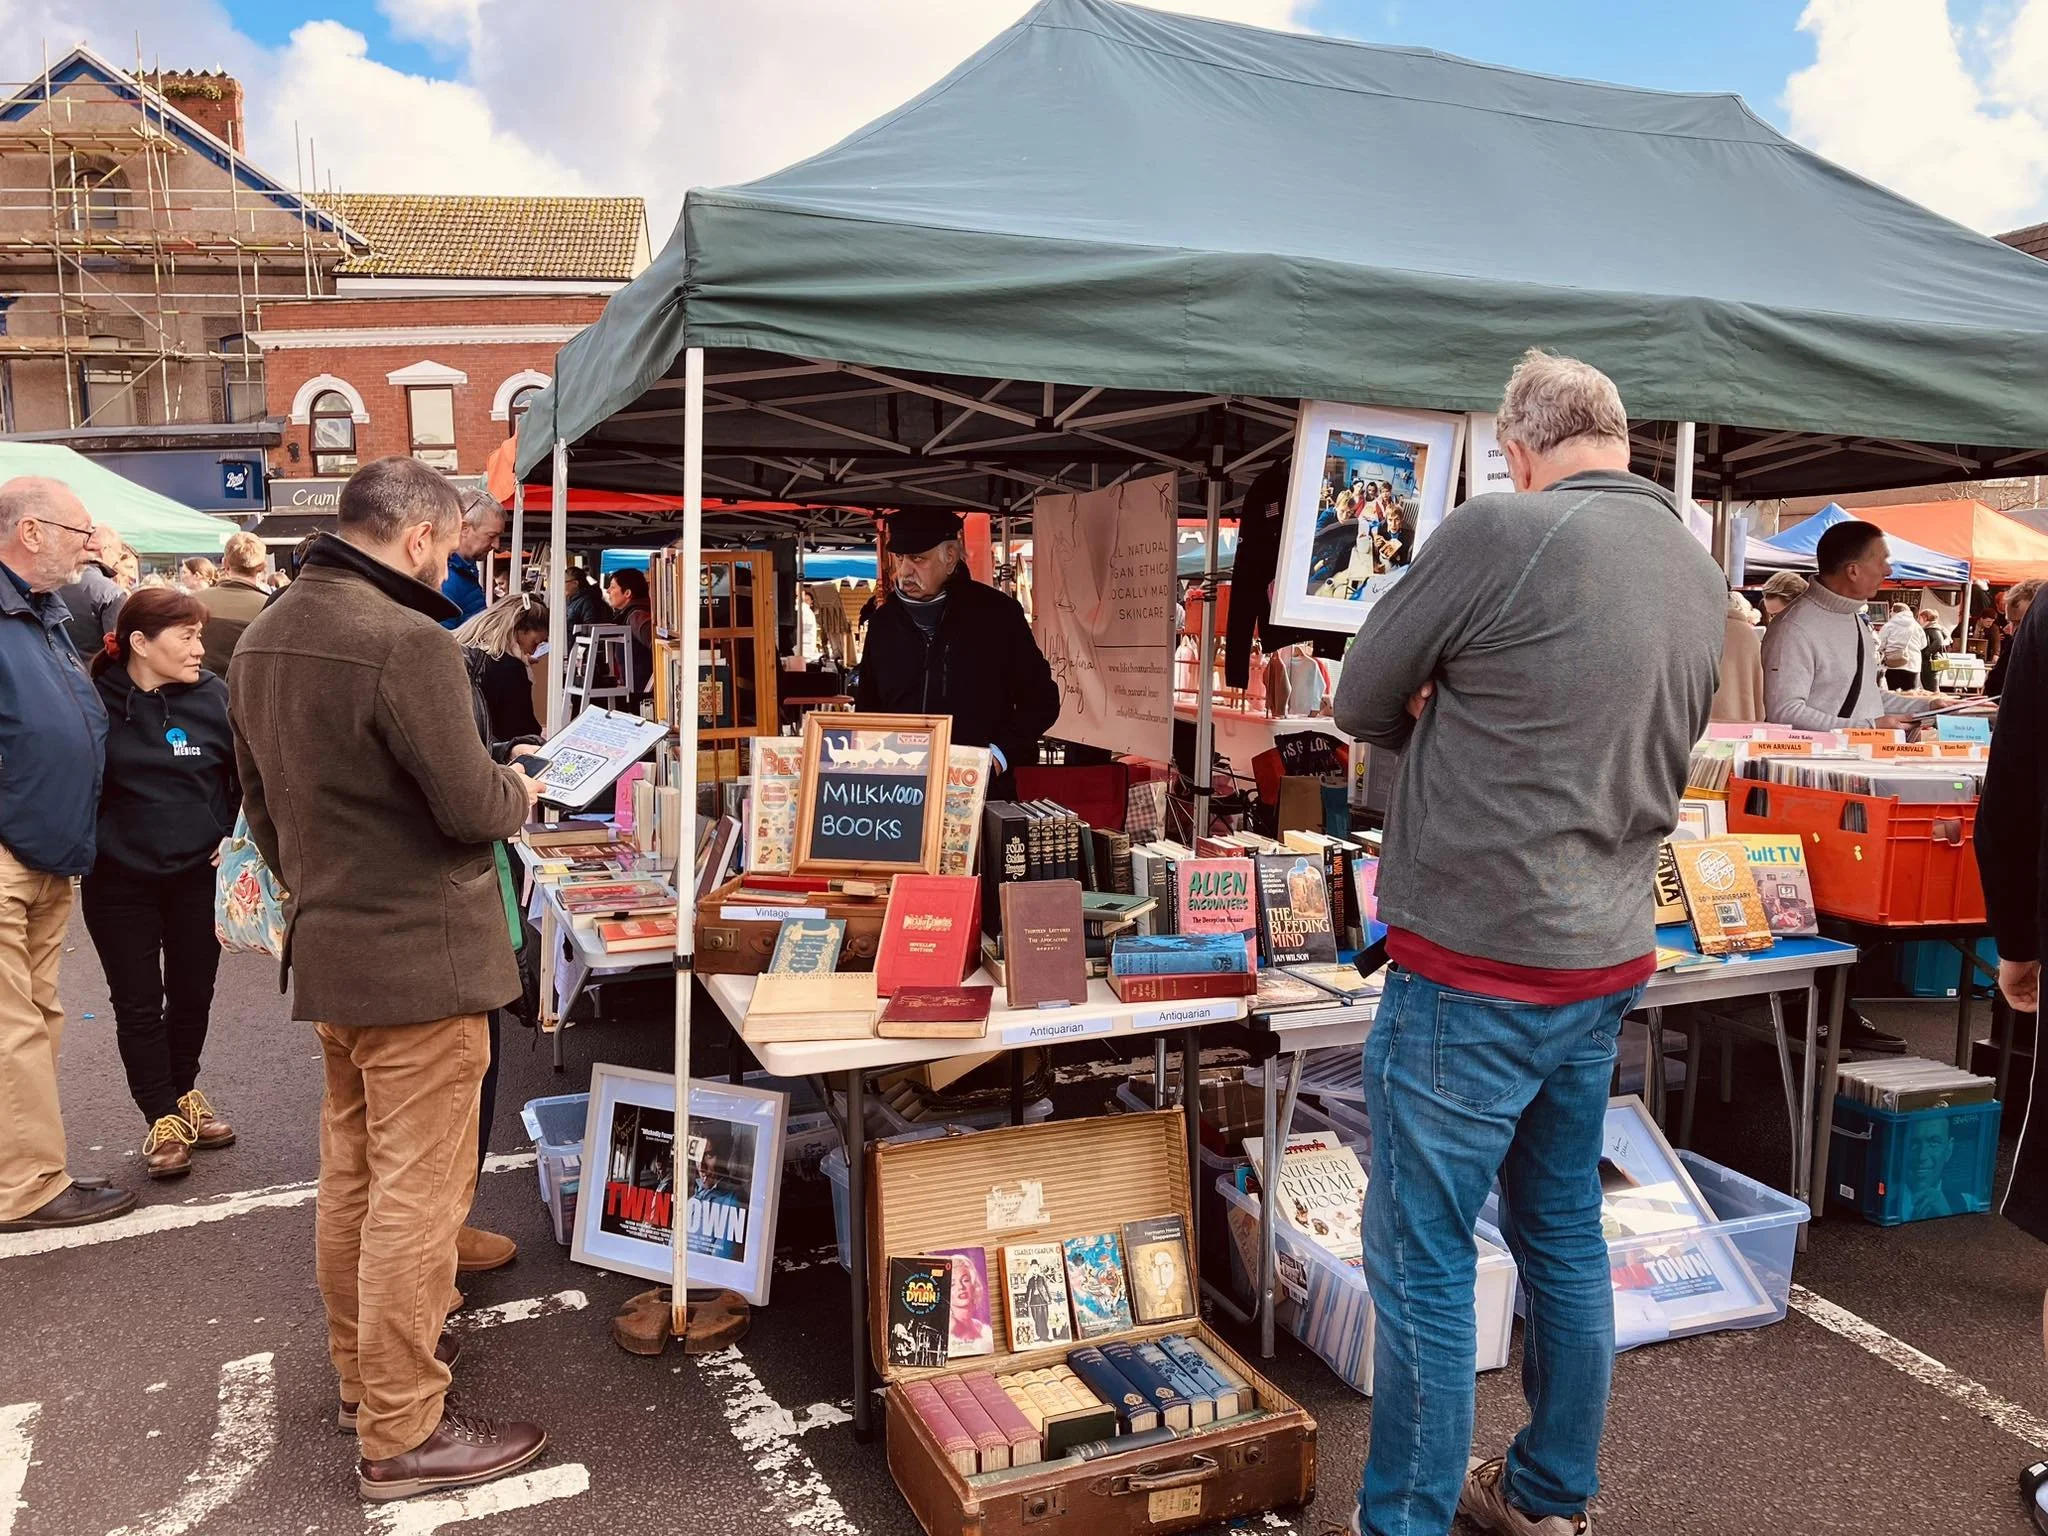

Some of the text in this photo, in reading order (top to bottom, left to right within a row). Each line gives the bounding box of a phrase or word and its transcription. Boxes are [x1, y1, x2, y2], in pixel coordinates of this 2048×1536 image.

[1128, 540, 1168, 556] NATURAL
[1120, 606, 1164, 620] SKINCARE
[172, 740, 188, 748] CAP
[174, 746, 201, 756] MEDICS
[823, 780, 924, 807] MILKWOOD
[821, 814, 902, 842] BOOKS
[1006, 843, 1025, 854] FOLIO
[1777, 846, 1800, 862] TV
[1333, 855, 1344, 876] INSIDE
[1189, 870, 1248, 897] ALIEN
[1334, 877, 1344, 889] THE
[1712, 892, 1751, 902] ANNIVERSARY
[1188, 898, 1248, 911] ENCOUNTERS
[755, 908, 790, 919] Vintage
[1192, 916, 1202, 924] The
[1202, 916, 1226, 924] Deception
[1266, 908, 1290, 921] THE
[1269, 919, 1330, 935] BLEEDING
[1271, 934, 1304, 948] MIND
[1273, 953, 1310, 962] IAN WILSON
[1159, 1008, 1210, 1021] Antiquarian
[1030, 1023, 1084, 1036] Antiquarian
[1280, 1159, 1351, 1178] NURSERY
[1282, 1172, 1358, 1197] RHYME
[1306, 1191, 1356, 1210] BOOK
[606, 1181, 670, 1228] TWIN
[671, 1194, 746, 1244] OWN
[1644, 1253, 1713, 1284] TOWN
[908, 1282, 934, 1292] BOB
[906, 1290, 936, 1303] DYLAN
